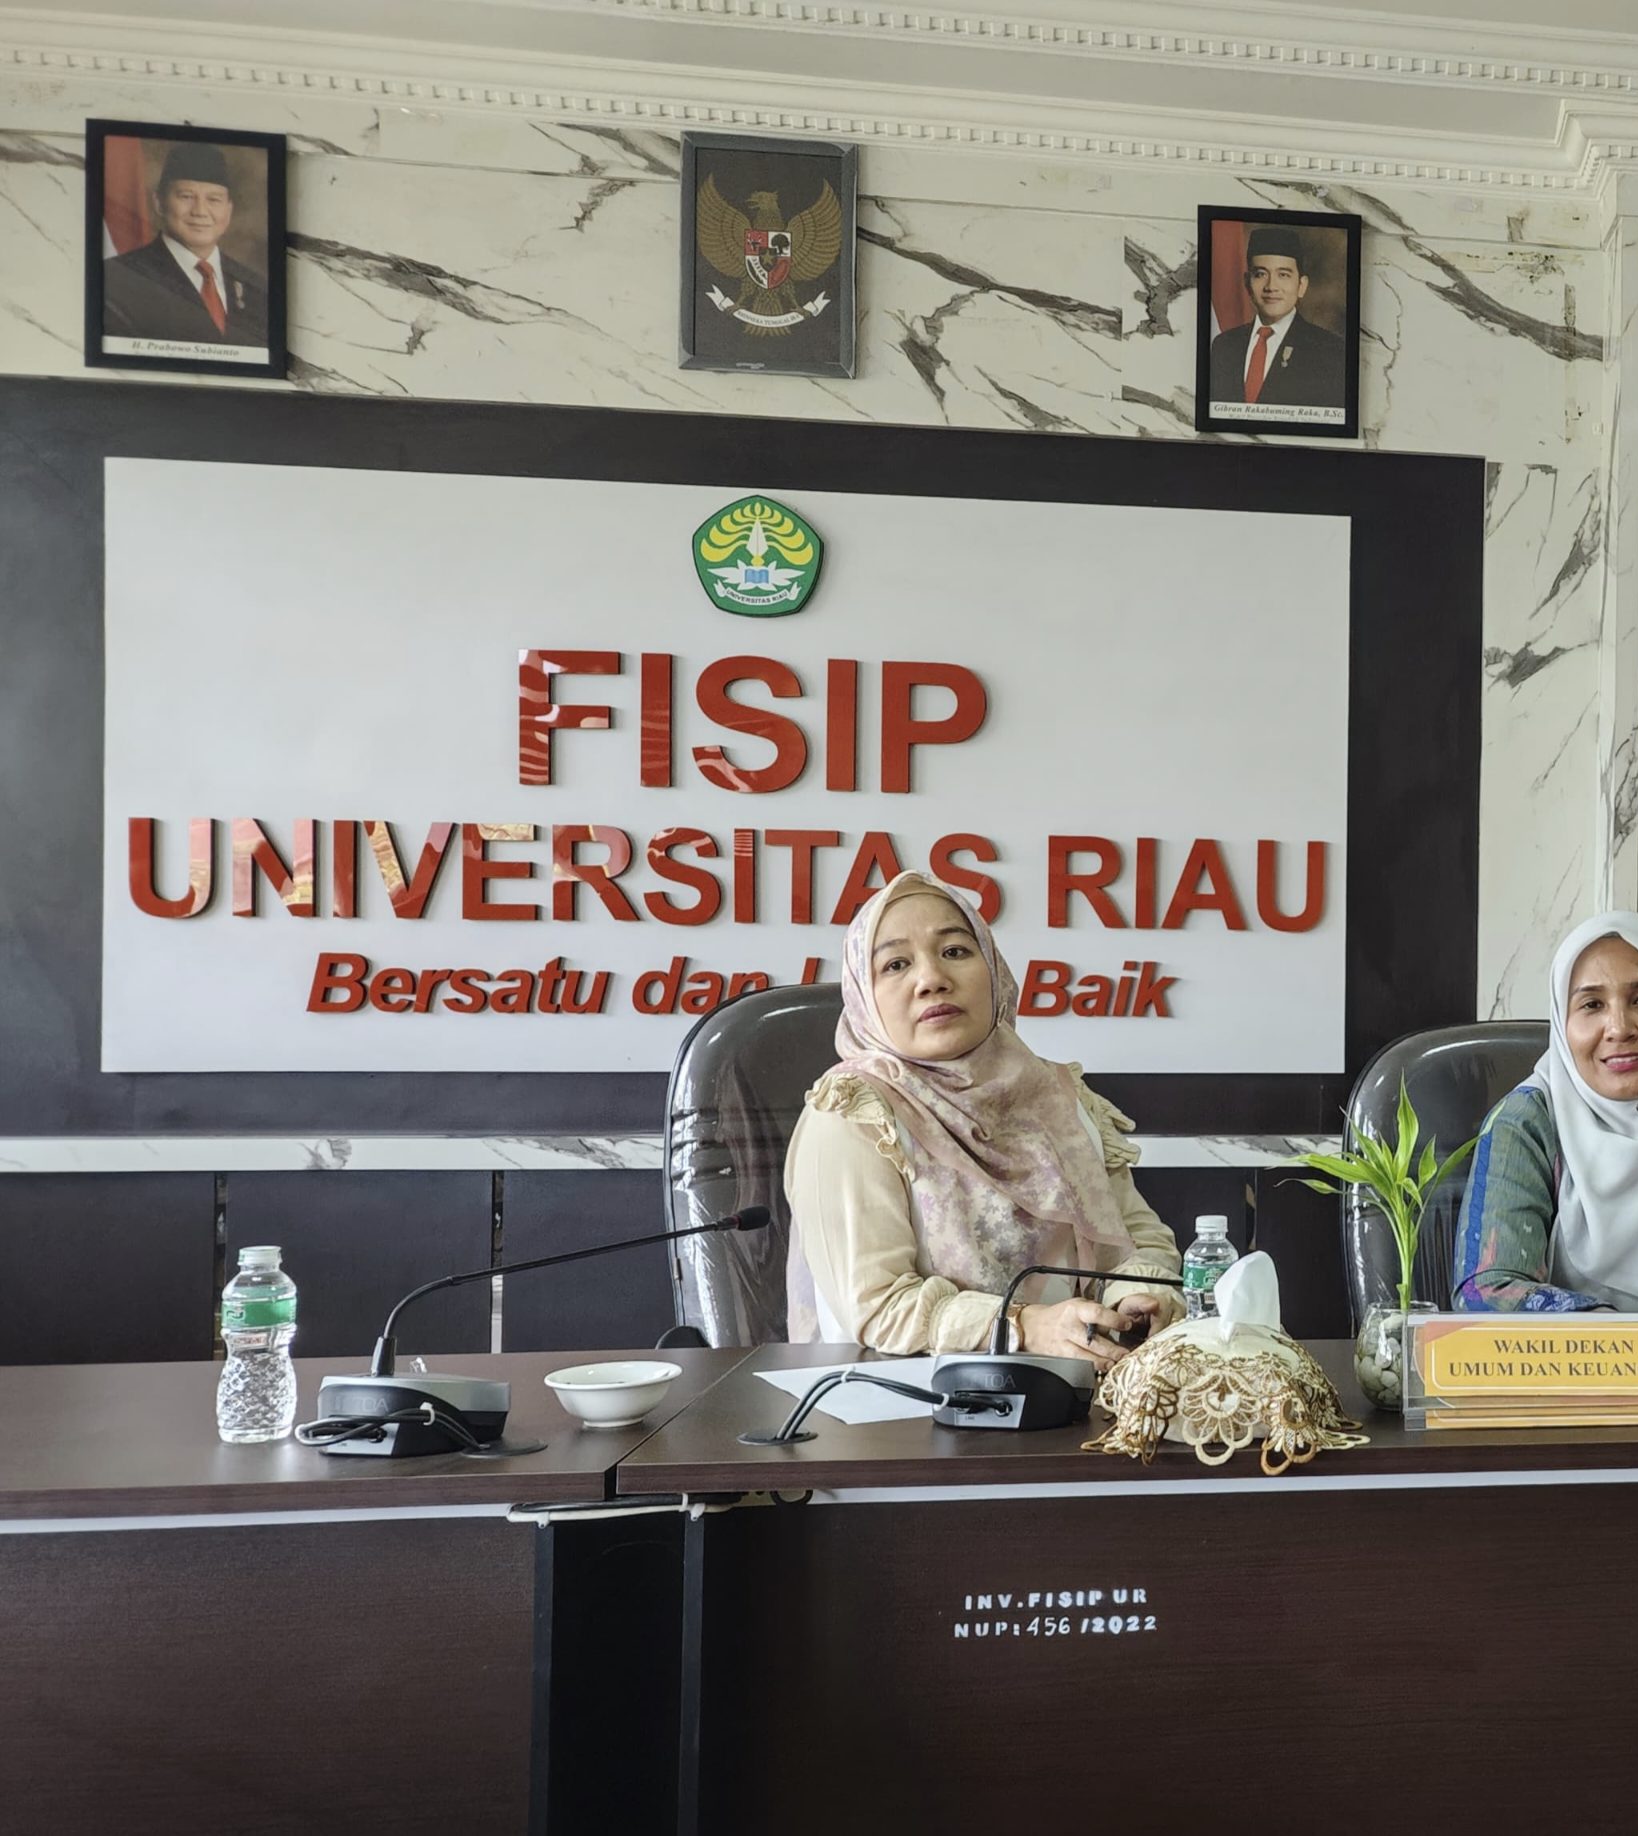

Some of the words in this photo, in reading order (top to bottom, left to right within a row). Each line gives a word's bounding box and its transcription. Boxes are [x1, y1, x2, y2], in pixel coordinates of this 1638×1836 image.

[1214, 404, 1242, 412] Gibran
[1245, 406, 1295, 416] Rakabuming
[727, 589, 770, 604] UNIVERSITAS
[772, 592, 787, 601] RIAU
[519, 649, 987, 794] FISIP
[128, 817, 1005, 927] UNIVERSITAS
[1048, 835, 1326, 933] RIAU
[306, 952, 610, 1016] Bersatu
[632, 957, 771, 1016] dan
[1018, 959, 1178, 1019] Baik
[1494, 1339, 1560, 1354] WAKIL
[1566, 1339, 1634, 1354] DEKAN
[1449, 1362, 1514, 1377] UMUM
[1521, 1362, 1562, 1377] DAN
